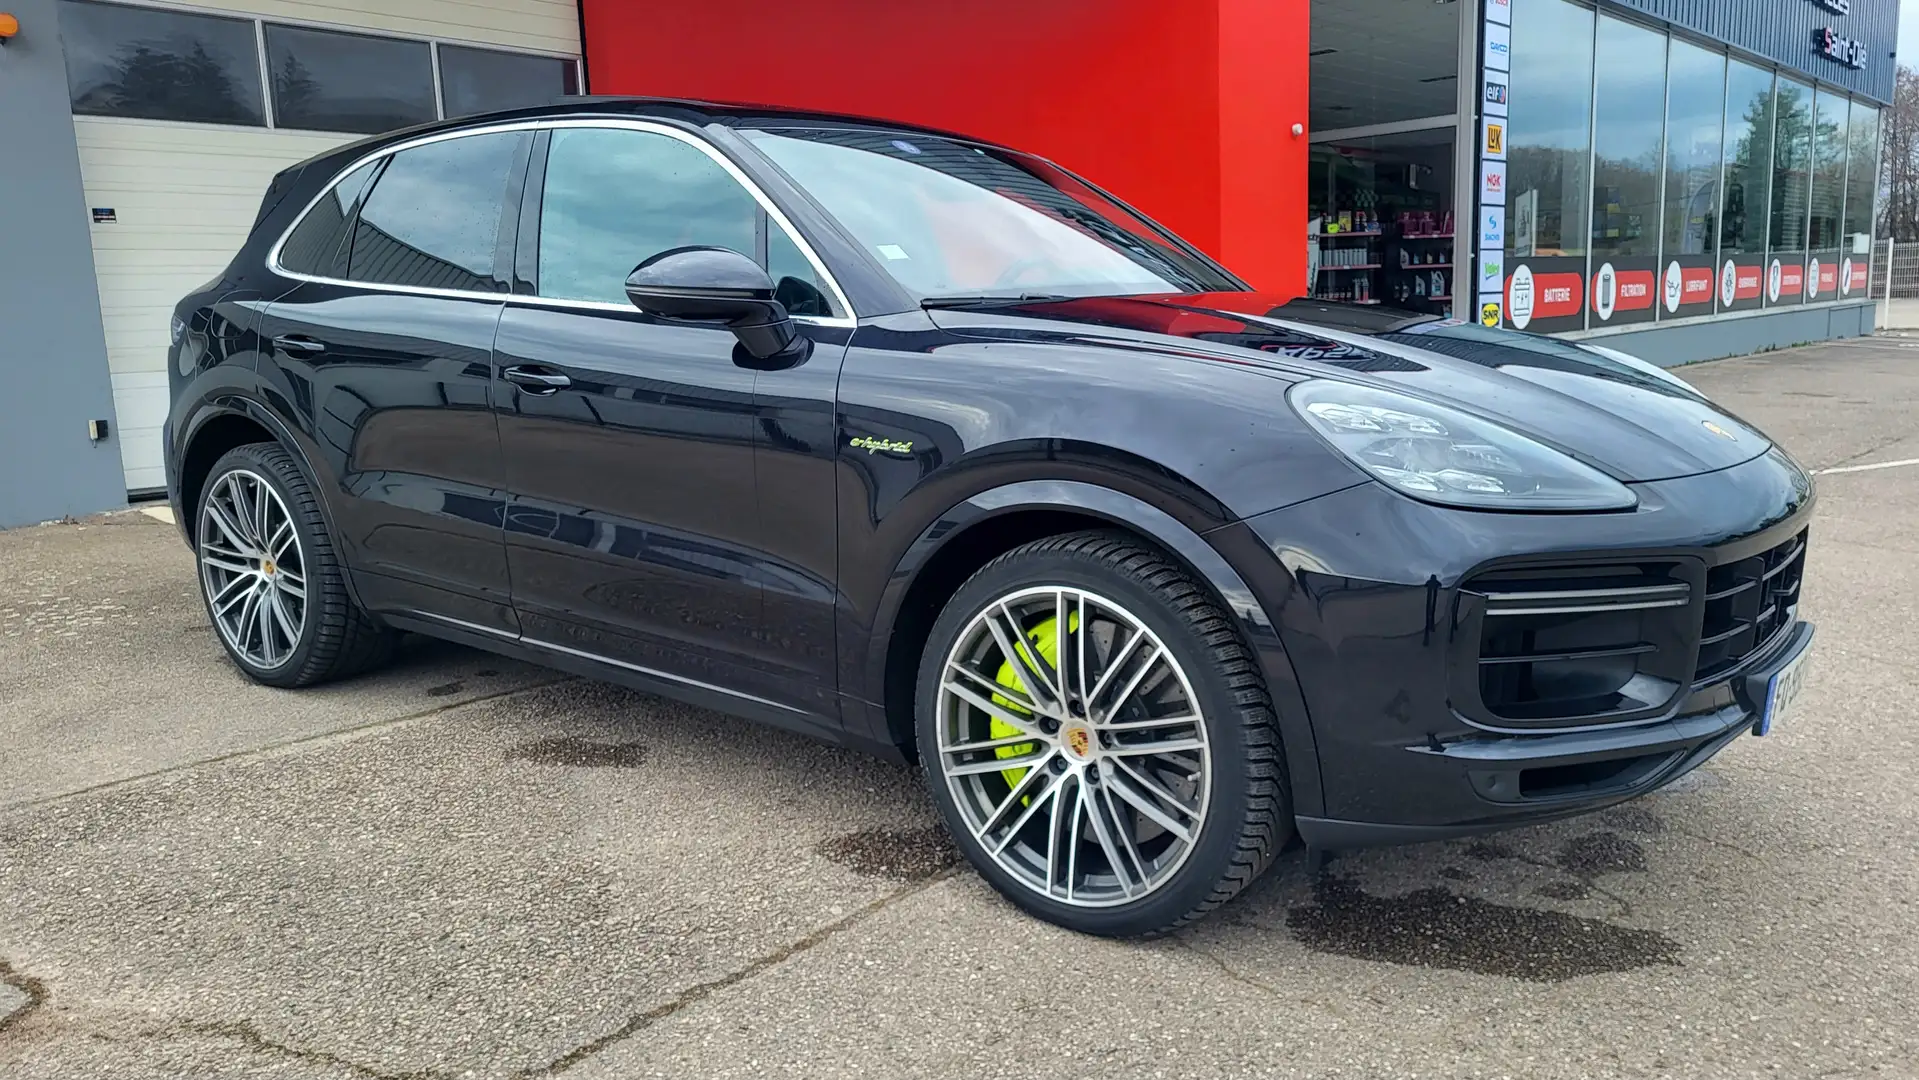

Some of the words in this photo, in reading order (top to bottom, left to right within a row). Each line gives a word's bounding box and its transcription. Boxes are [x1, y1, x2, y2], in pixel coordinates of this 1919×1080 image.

[1824, 26, 1867, 70] Saint-Dié
[1486, 85, 1499, 100] elf
[1487, 173, 1501, 187] NGK
[1543, 287, 1571, 303] BATTERIE
[1620, 283, 1647, 297] FILTRATION
[1482, 309, 1498, 320] SNR
[849, 436, 913, 455] e-hybrid
